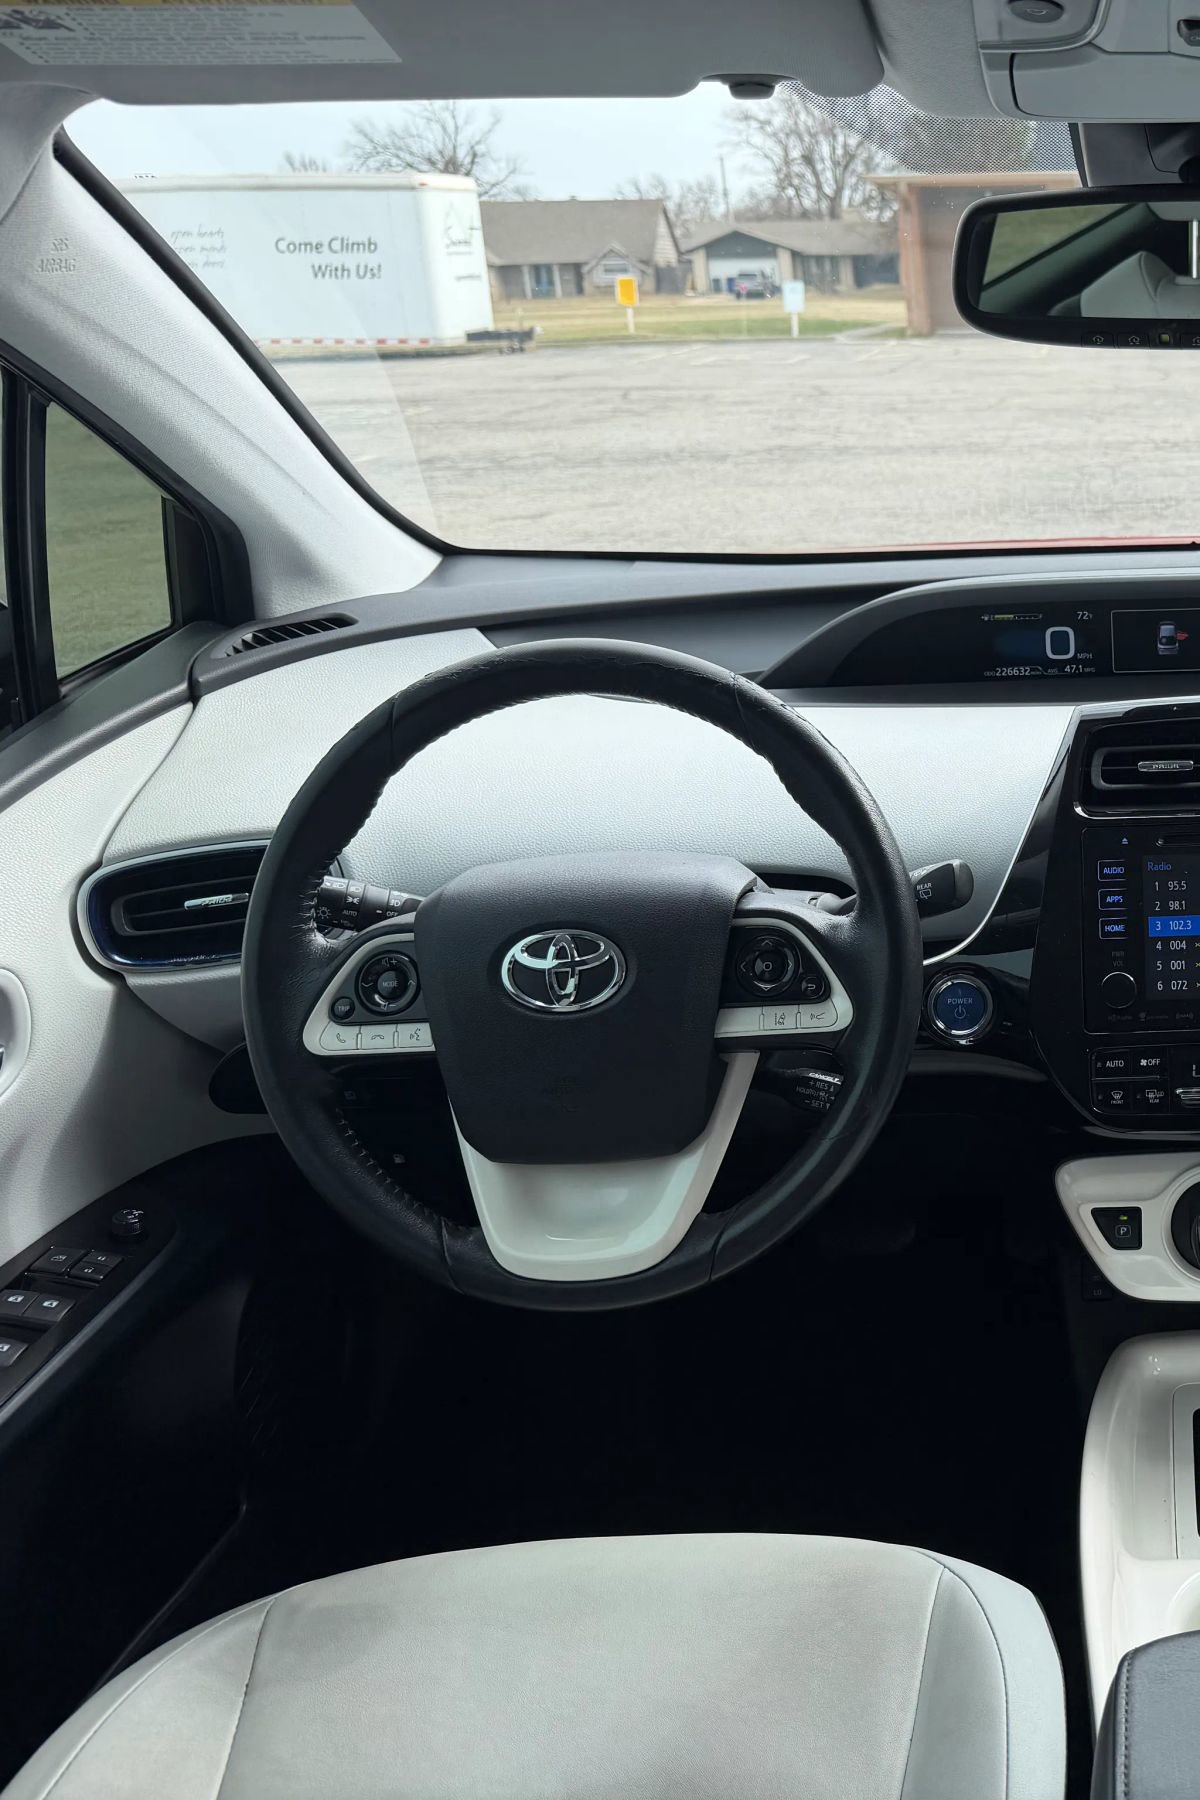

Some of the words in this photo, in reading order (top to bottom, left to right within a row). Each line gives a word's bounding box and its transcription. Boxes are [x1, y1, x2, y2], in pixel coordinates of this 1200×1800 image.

[274, 237, 324, 254] Come
[328, 236, 378, 254] Climb
[311, 263, 351, 280] With
[355, 263, 382, 280] Us!
[1045, 626, 1076, 660] 0
[1077, 652, 1093, 660] MPH
[995, 667, 1031, 677] 226632
[1064, 664, 1083, 674] 47.1
[1103, 866, 1125, 875] AUDIO
[1147, 861, 1172, 872] Radio
[916, 882, 932, 891] REAR
[1167, 880, 1188, 891] 95.5
[1106, 895, 1124, 904] APPS
[1155, 901, 1161, 911] 2
[1168, 900, 1187, 911] 98.1
[1104, 924, 1126, 933] HOME
[1155, 921, 1161, 931] 3
[1169, 920, 1193, 931] 102.3
[1156, 941, 1163, 951] 4
[1169, 940, 1187, 951] 004
[1156, 960, 1162, 970] 5
[1170, 960, 1186, 970] 001
[1157, 981, 1163, 991] 6
[1171, 980, 1188, 991] 072
[947, 998, 973, 1006] POWER
[1105, 1060, 1125, 1068] AUTO
[1148, 1058, 1161, 1066] OFF
